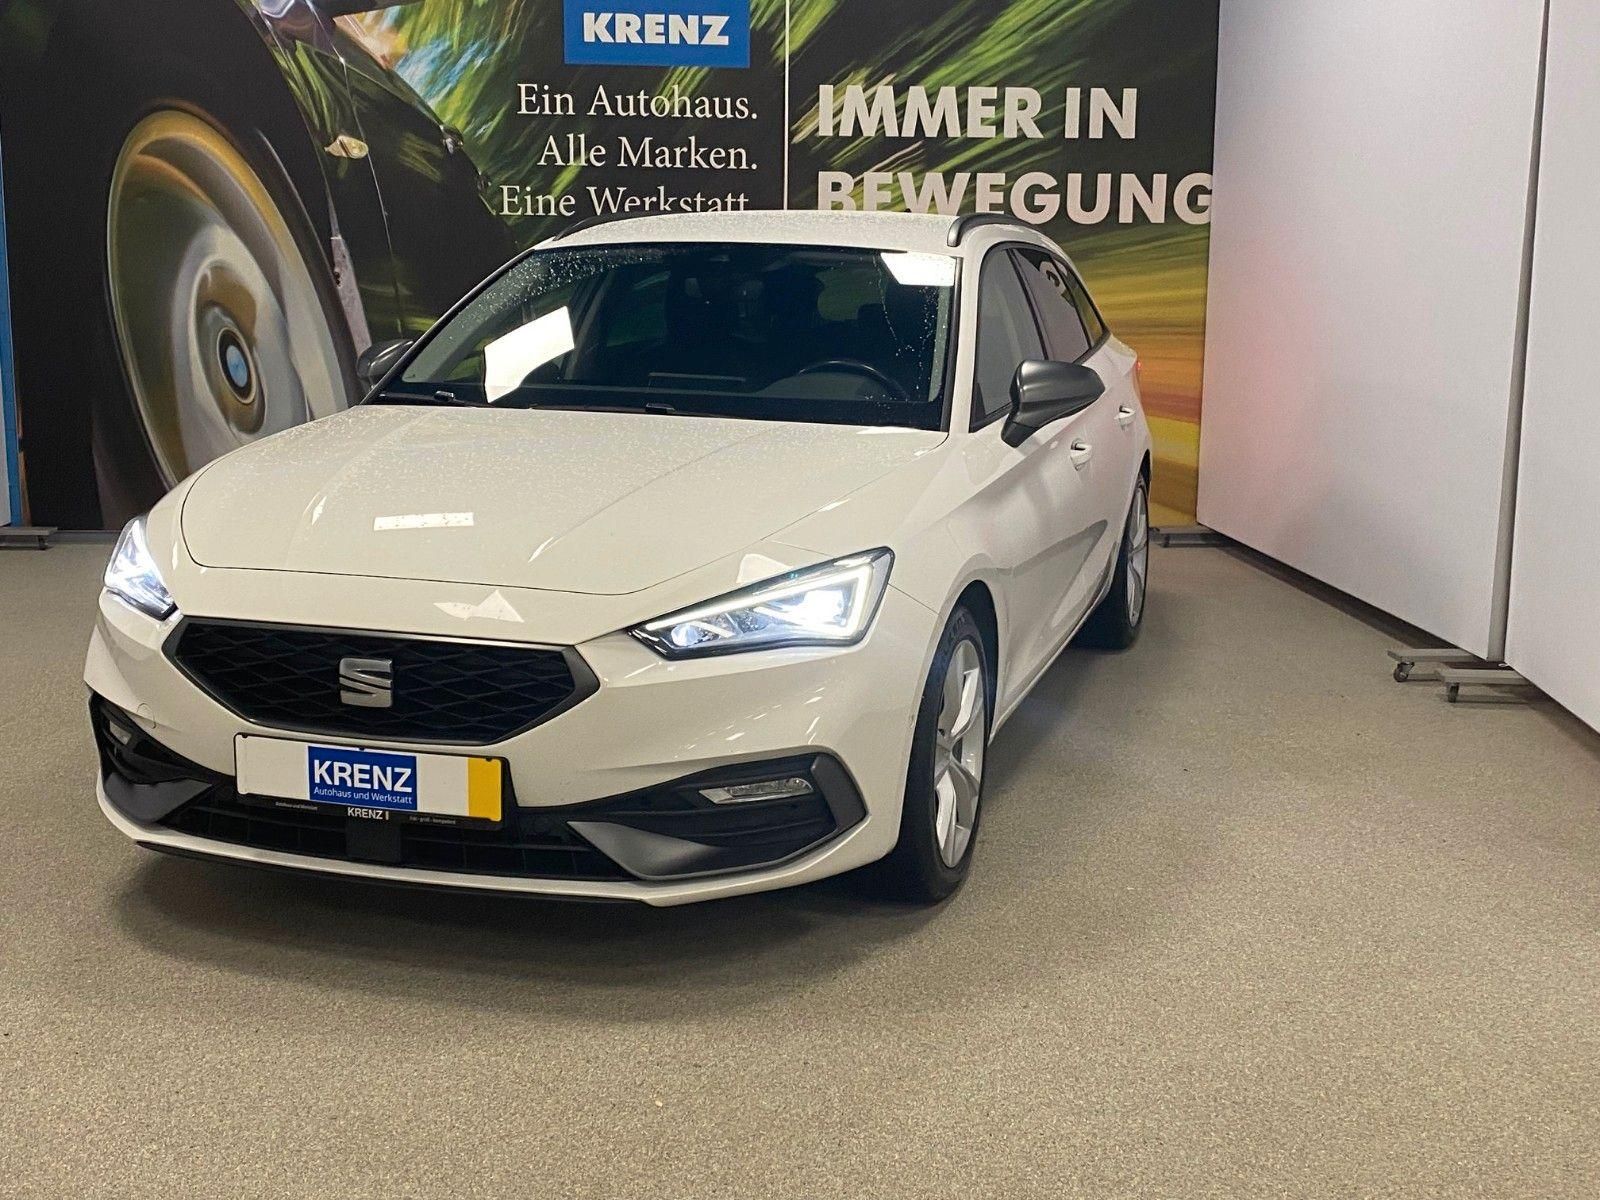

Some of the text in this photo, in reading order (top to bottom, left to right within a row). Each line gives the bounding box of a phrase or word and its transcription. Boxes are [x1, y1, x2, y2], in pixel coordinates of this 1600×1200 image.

[583, 12, 730, 46] KRENZ
[516, 83, 758, 120] Ein Autohaus.
[817, 84, 1138, 139] IMMER IN
[536, 133, 758, 170] Alle Marken.
[499, 185, 576, 217] Eine
[817, 171, 1213, 225] BEWEGUNG
[313, 759, 413, 793] KRENZ
[313, 786, 413, 805] Autohaus und Werkstatt
[347, 806, 383, 820] KRENZ
